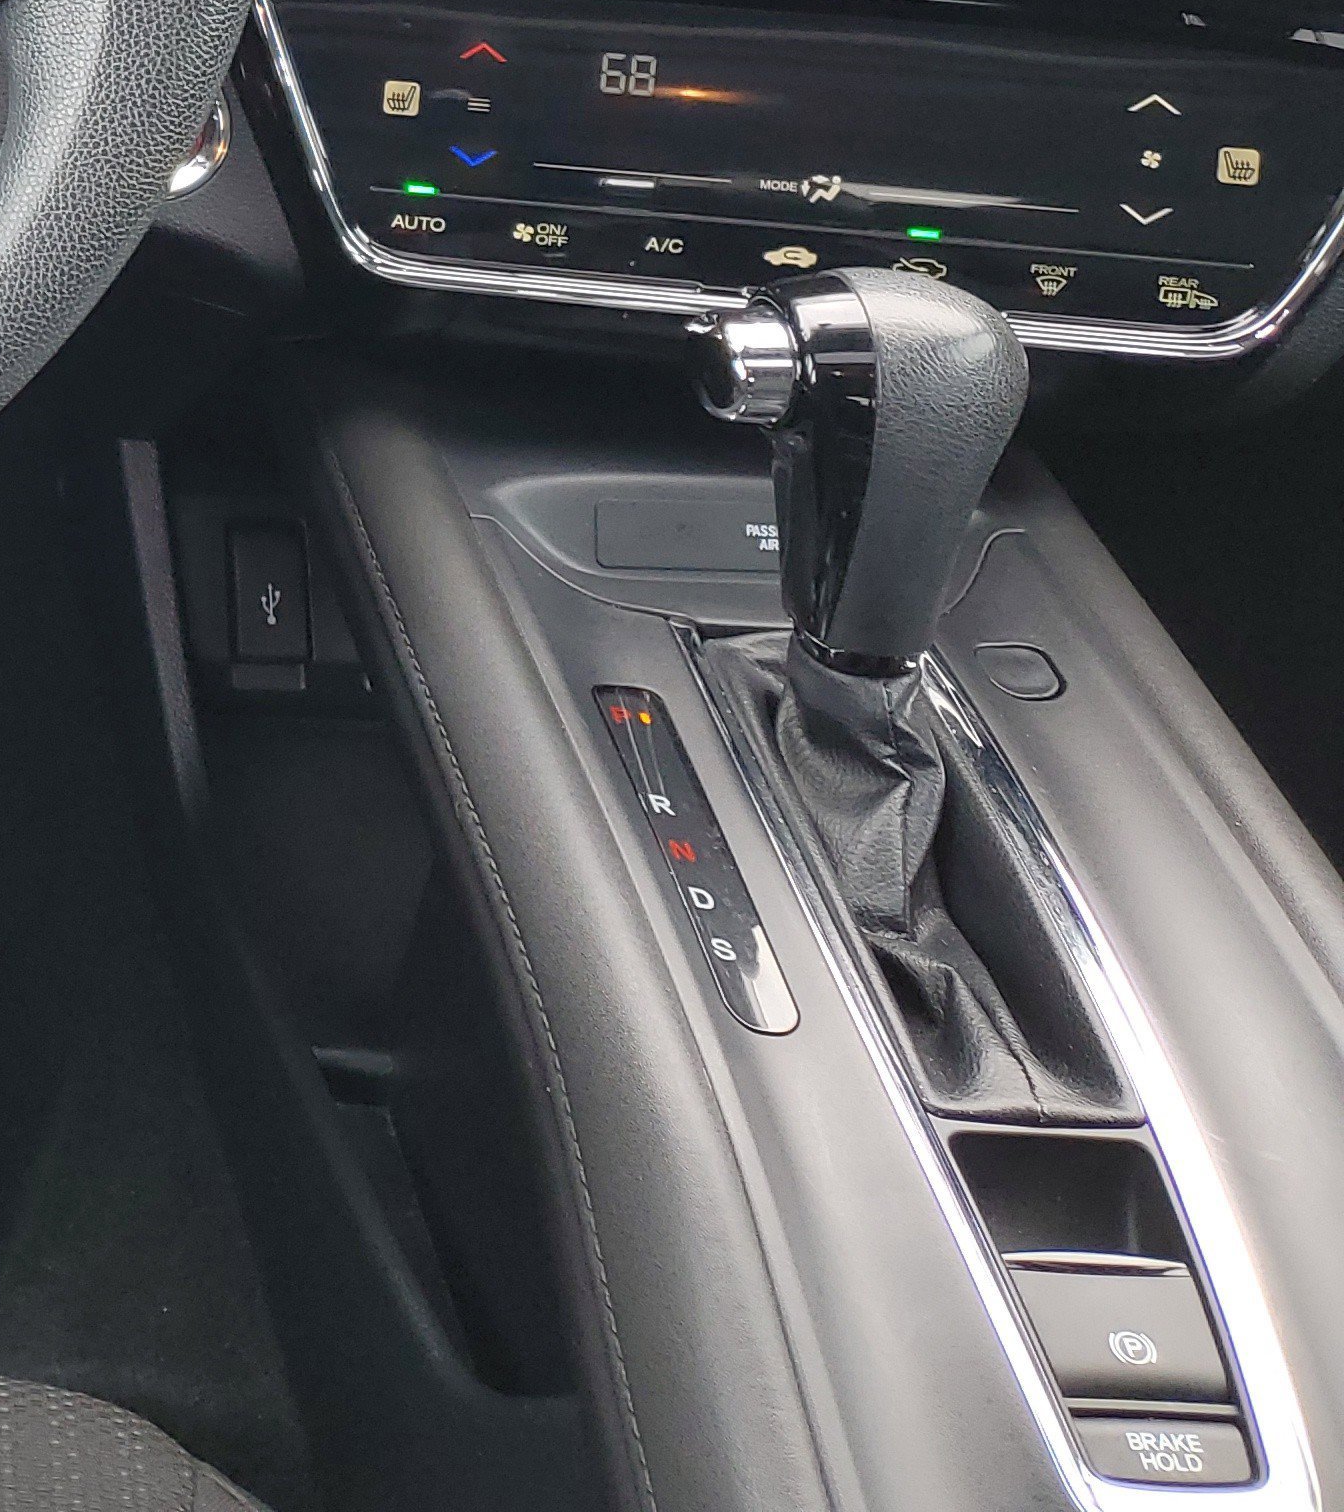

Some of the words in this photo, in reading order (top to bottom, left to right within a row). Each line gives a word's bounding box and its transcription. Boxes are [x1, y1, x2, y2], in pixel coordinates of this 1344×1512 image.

[600, 52, 657, 97] 68
[759, 179, 798, 193] MODE
[391, 214, 446, 233] AUTO
[535, 234, 569, 247] OFF
[645, 237, 685, 255] A/C
[1030, 264, 1077, 278] FRONT
[1158, 275, 1200, 289] REAR
[649, 794, 676, 817] R
[668, 839, 697, 863] N
[690, 887, 715, 910] D
[711, 938, 737, 962] S
[1125, 1432, 1204, 1453] BRAKE
[1139, 1452, 1203, 1473] HOLD
